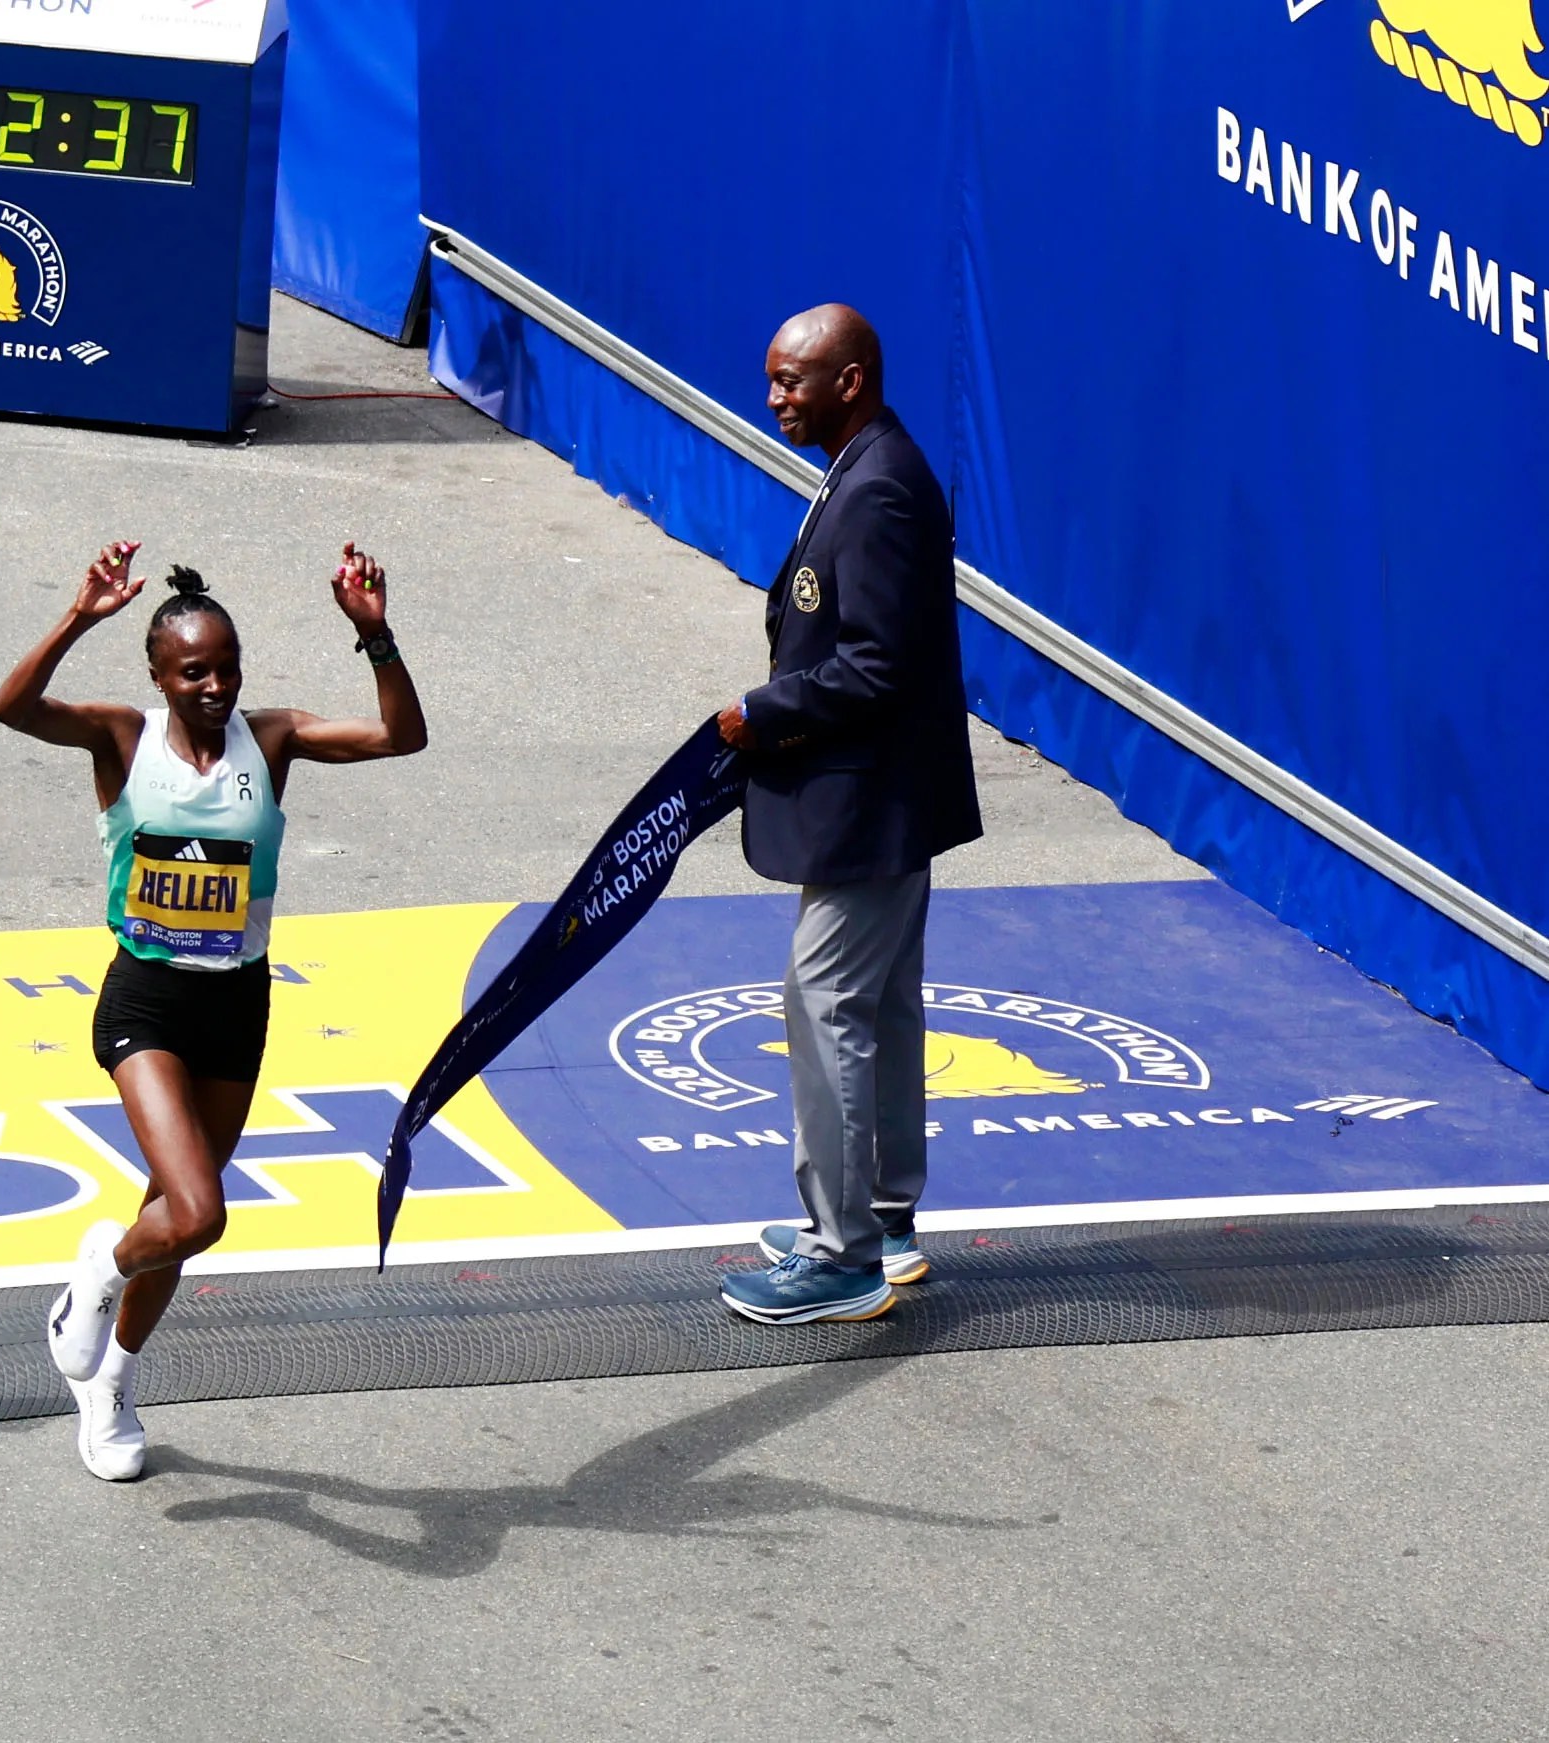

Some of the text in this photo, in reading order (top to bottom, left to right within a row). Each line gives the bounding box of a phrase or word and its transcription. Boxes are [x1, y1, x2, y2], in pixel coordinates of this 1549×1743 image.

[1217, 106, 1549, 361] BANK OF AME
[0, 208, 61, 312] MARATHON
[149, 780, 179, 793] OAC
[612, 789, 687, 866] BOSTON
[138, 867, 238, 914] HELLEN
[583, 817, 691, 926] MARATHON
[150, 930, 203, 947] MARATHON
[166, 930, 203, 940] BOSTON
[635, 990, 785, 1043] BOSTO
[635, 1049, 738, 1101] 128TH
[637, 1128, 796, 1154] BAN
[972, 1106, 1295, 1136] AMERICA
